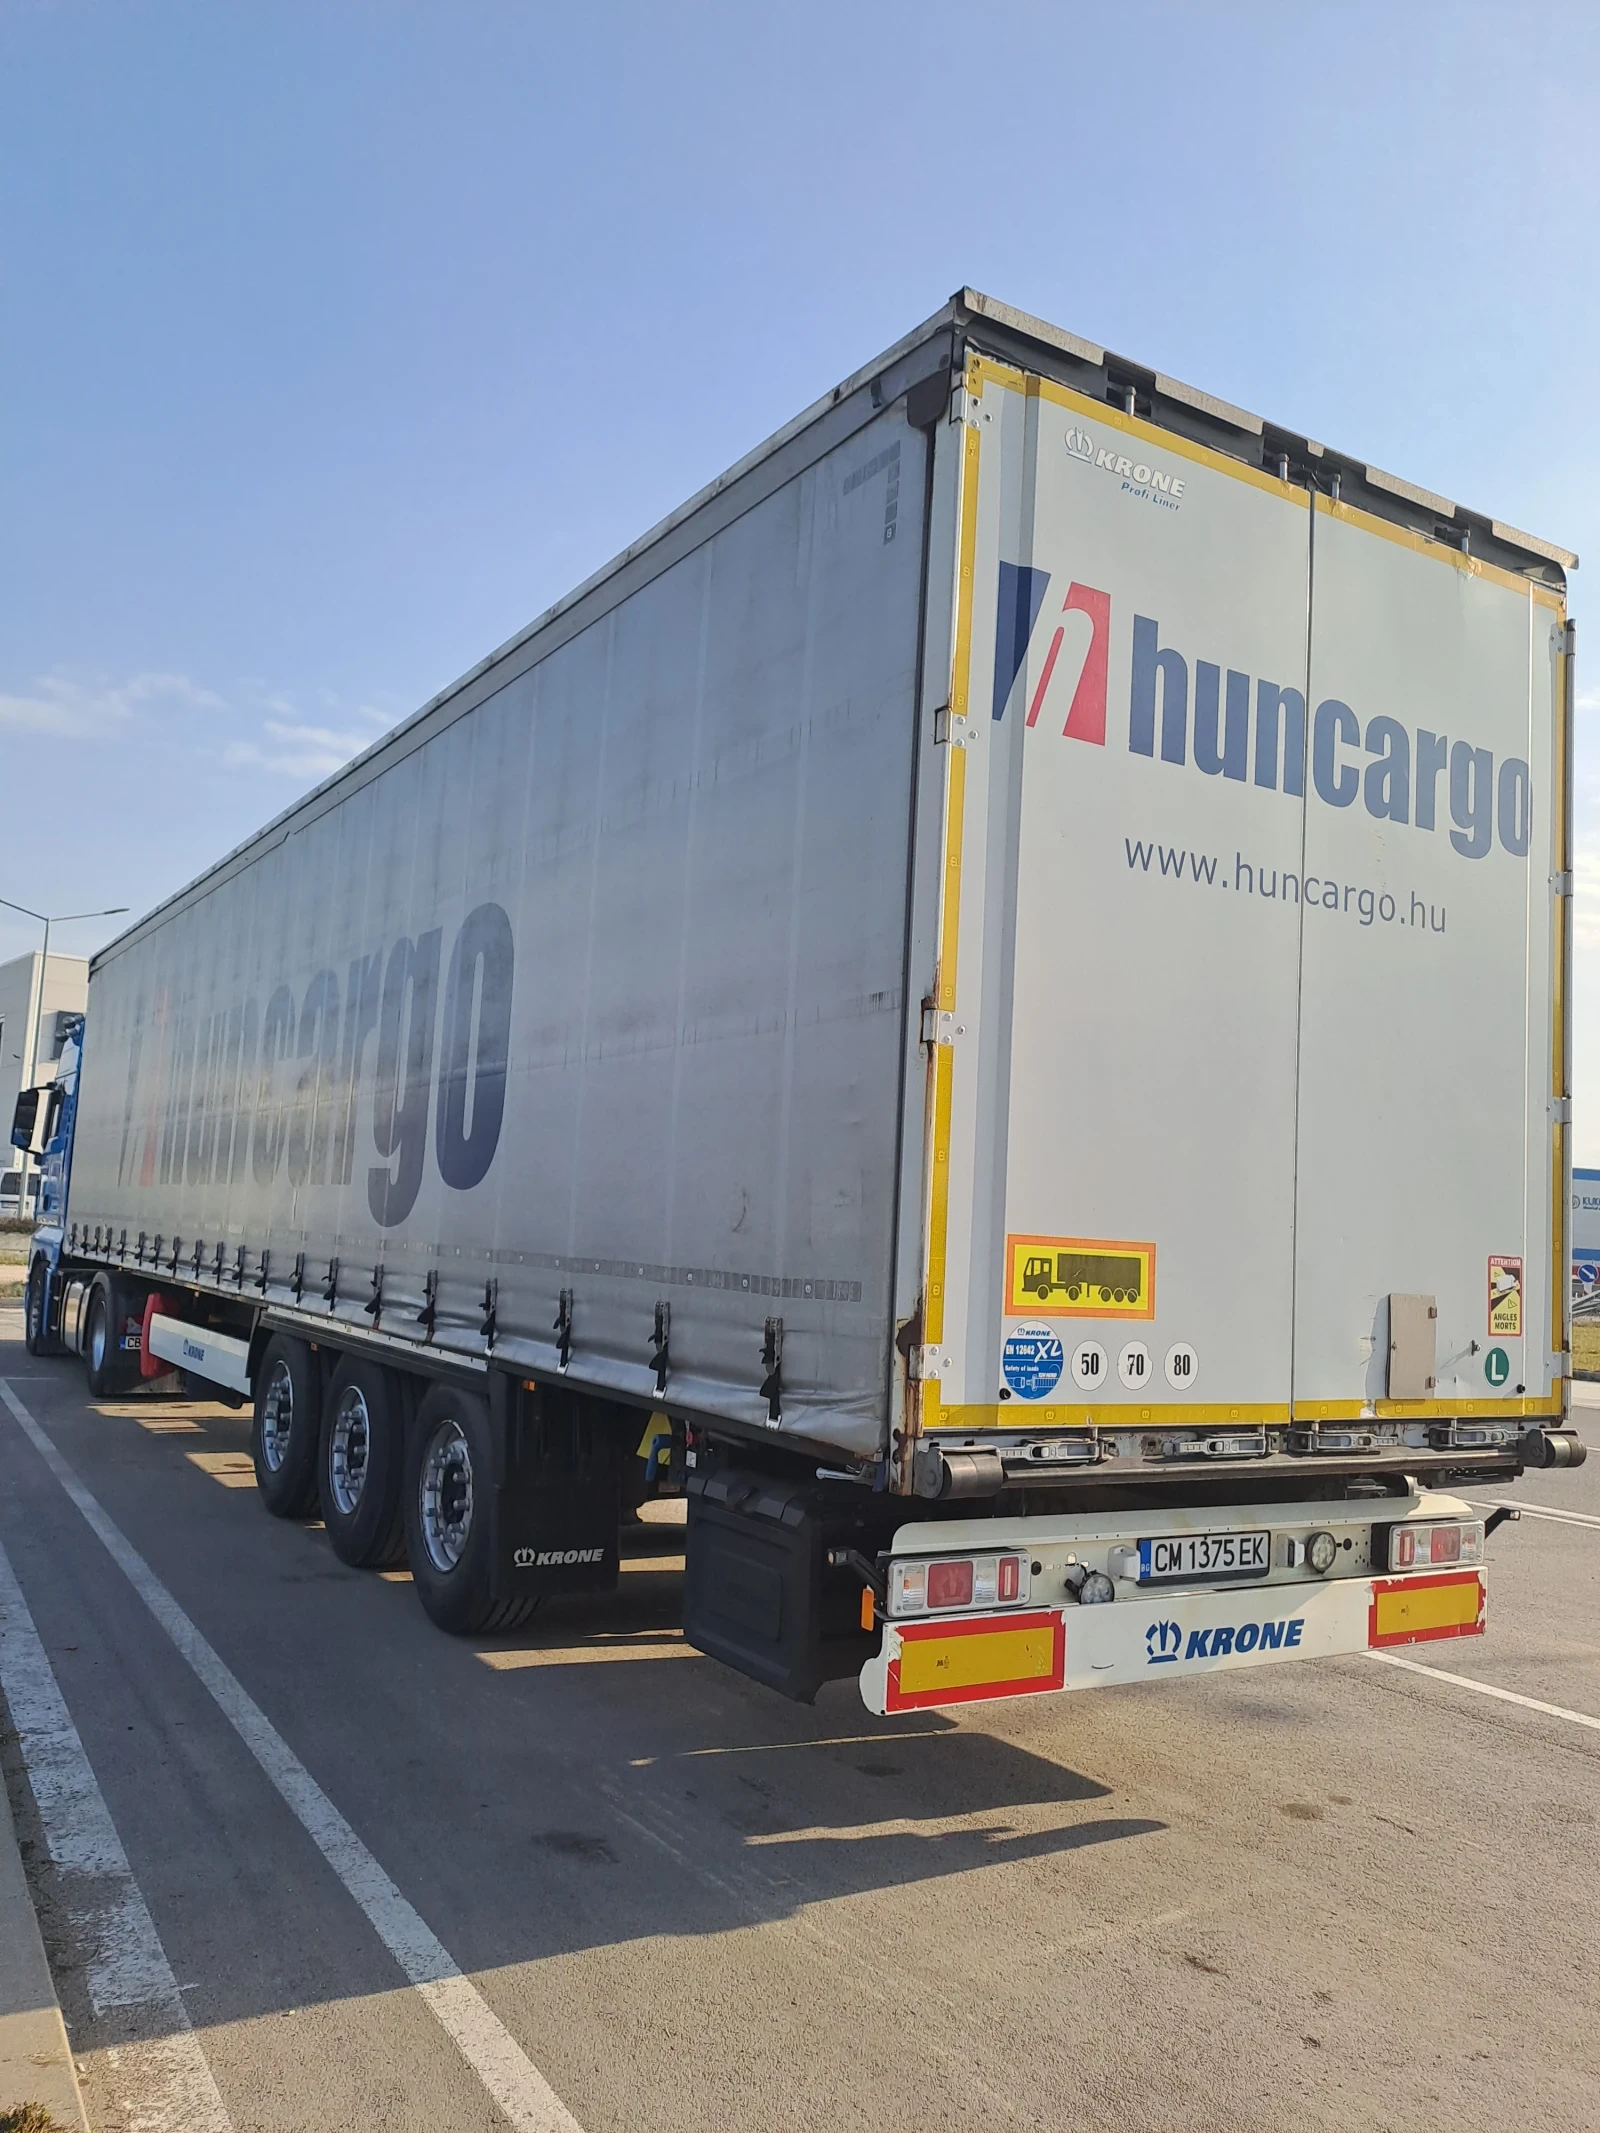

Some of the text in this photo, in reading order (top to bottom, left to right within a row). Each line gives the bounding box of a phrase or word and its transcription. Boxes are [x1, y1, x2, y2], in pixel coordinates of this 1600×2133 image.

[1095, 448, 1186, 499] KRONE
[1121, 481, 1181, 511] Profi Liner
[1128, 613, 1533, 860] huncargo
[1124, 837, 1447, 933] www.huncargo.hu
[1490, 1257, 1521, 1267] ATTENTION
[1493, 1312, 1518, 1321] ANGLES
[1494, 1322, 1517, 1331] MORTS
[1025, 1329, 1051, 1337] KRONE
[1033, 1339, 1062, 1363] XL
[1005, 1365, 1020, 1373] Safety
[1081, 1352, 1099, 1376] 50
[1127, 1353, 1144, 1376] 70
[1173, 1354, 1190, 1376] 80
[1491, 1353, 1504, 1381] L
[536, 1548, 604, 1566] KRONE
[1188, 1538, 1235, 1569] 1375
[1239, 1536, 1264, 1566] EK
[1140, 1563, 1150, 1572] BG
[1184, 1618, 1305, 1659] KRONE
